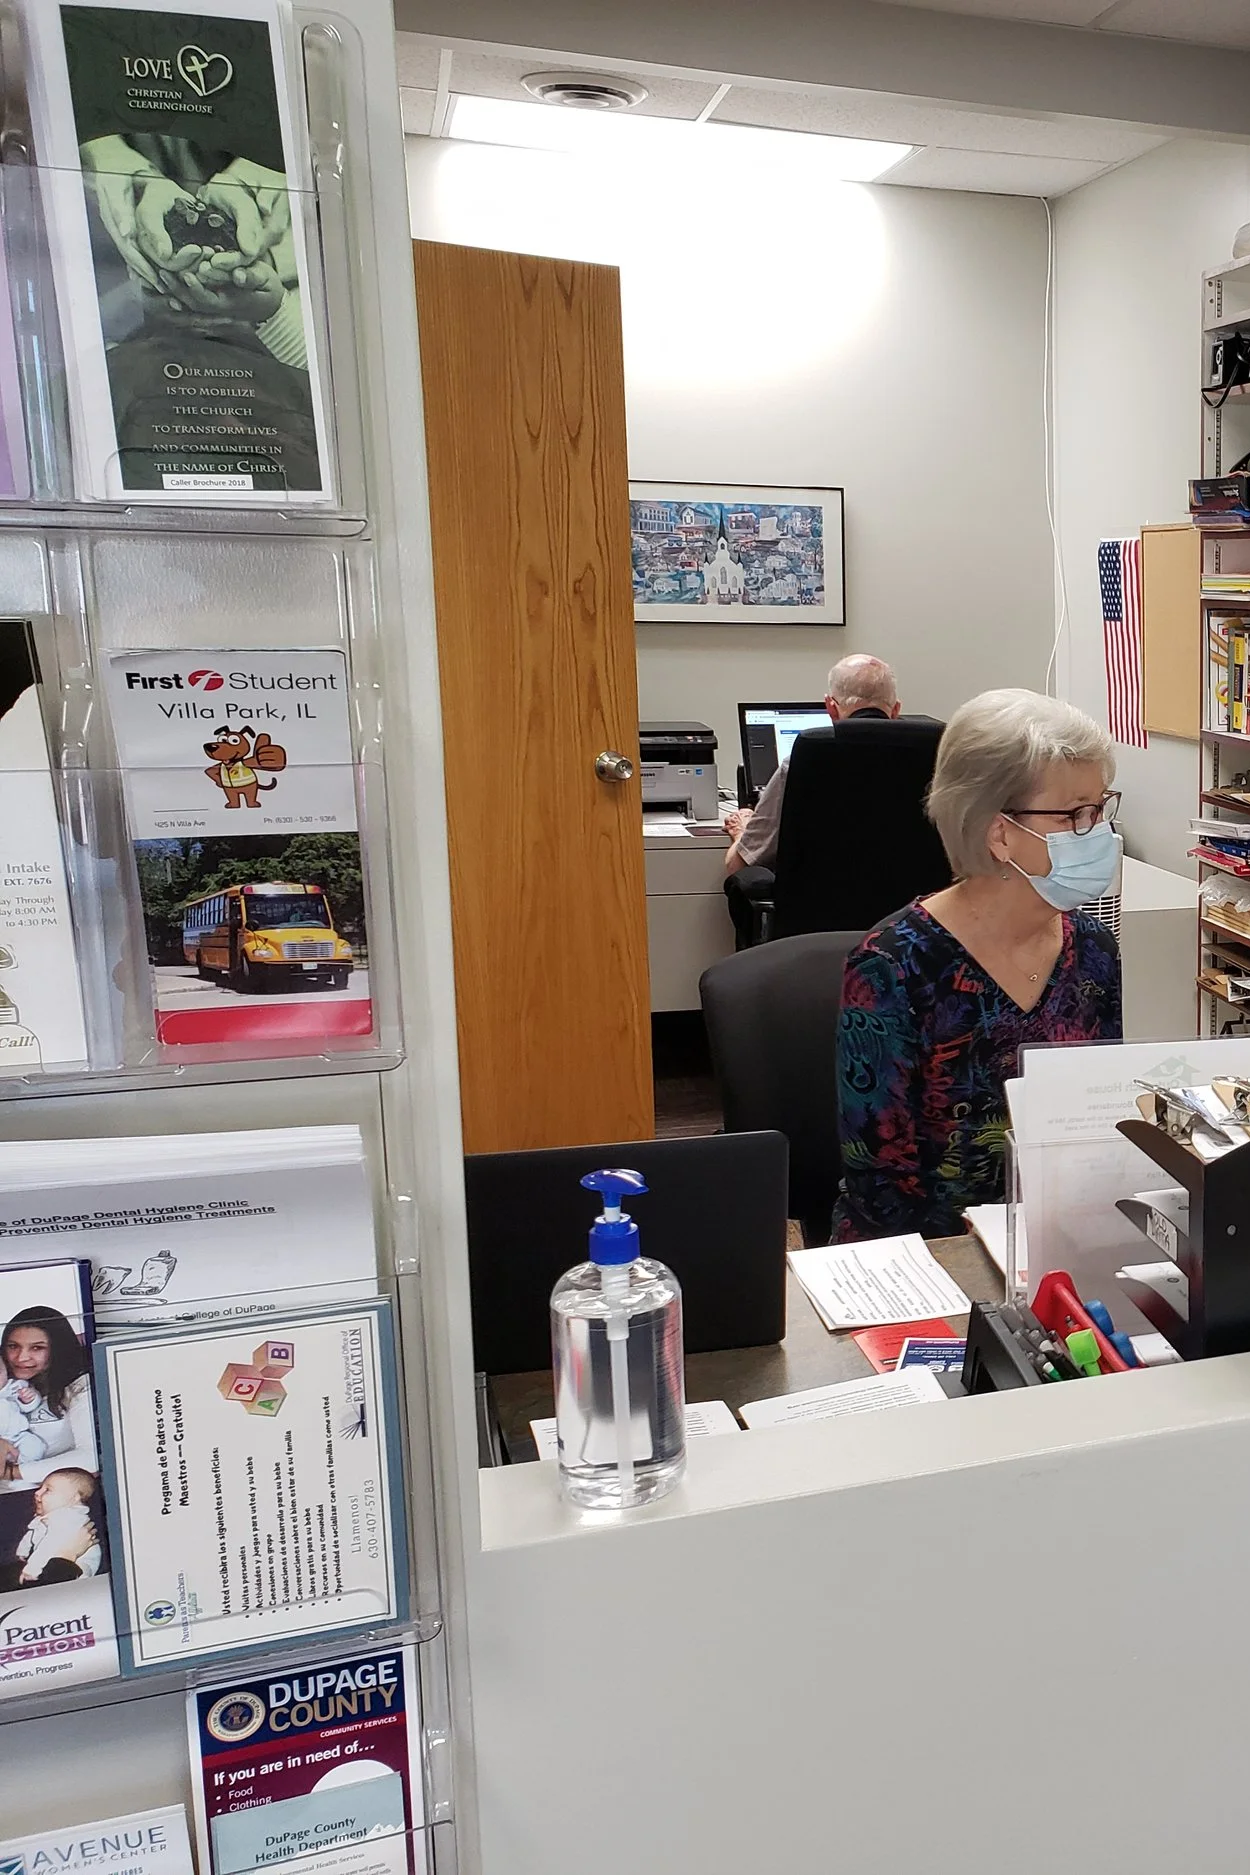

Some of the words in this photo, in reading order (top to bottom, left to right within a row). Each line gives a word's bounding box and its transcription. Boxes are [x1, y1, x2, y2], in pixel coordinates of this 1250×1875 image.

[122, 57, 173, 80] LOVE
[127, 88, 182, 99] CHRISTIAN
[128, 100, 213, 114] CLEARINGHOUSE
[203, 369, 253, 378] MISSION
[166, 386, 176, 395] IS
[179, 387, 196, 396] TO
[199, 387, 256, 398] MOBILIZE
[172, 406, 198, 415] THE
[200, 406, 253, 416] CHURCH
[151, 425, 171, 433] TO
[172, 425, 245, 435] TRANSFORM
[247, 426, 278, 435] LIVES
[152, 444, 179, 453] AND
[181, 444, 267, 454] COMMUNITIES
[269, 446, 282, 454] IN
[154, 463, 179, 472] THE
[182, 463, 216, 472] NAME
[217, 463, 234, 472] OF
[193, 479, 227, 487] Brochure
[228, 479, 246, 487] 2018
[125, 672, 184, 690] First
[229, 672, 338, 690] Student
[158, 703, 215, 719] Villa
[225, 702, 287, 721] Park,
[297, 702, 317, 719] IL
[6, 861, 51, 874] Intake
[4, 878, 25, 886] EXT.
[27, 877, 52, 885] 7676
[15, 896, 55, 906] Through
[15, 907, 36, 915] 8:00
[39, 906, 56, 914] AM
[18, 919, 39, 927] 4:30
[41, 918, 58, 926] PM
[11, 1218, 26, 1226] of
[31, 1213, 90, 1224] DuPage
[93, 1208, 141, 1219] Dental
[145, 1204, 204, 1215] Hygiene
[208, 1199, 249, 1209] Clinic
[81, 1218, 129, 1229] Dental
[134, 1214, 193, 1226] Hygiene
[196, 1206, 276, 1219] Treatments
[223, 1307, 232, 1316] of
[349, 1328, 364, 1403] EDUCATION
[233, 1381, 255, 1397] C
[154, 1389, 163, 1416] como
[155, 1418, 167, 1454] Padres
[158, 1456, 168, 1469] de
[245, 1456, 254, 1475] bebe
[273, 1462, 282, 1480] bebe
[287, 1466, 295, 1477] de
[176, 1459, 191, 1506] Maestros
[246, 1476, 255, 1485] su
[159, 1470, 172, 1515] Progama
[276, 1491, 284, 1508] para
[248, 1493, 257, 1514] usted
[214, 1496, 227, 1540] siguientes
[250, 1515, 259, 1532] para
[303, 1508, 312, 1526] bebe
[363, 1479, 379, 1559] 630-407-5783
[291, 1524, 300, 1544] sobre
[216, 1542, 227, 1554] los
[280, 1546, 287, 1556] de
[306, 1536, 315, 1553] para
[331, 1539, 339, 1549] de
[239, 1545, 250, 1585] personales
[266, 1555, 274, 1564] en
[320, 1553, 327, 1562] en
[217, 1555, 230, 1588] recibira
[220, 1589, 232, 1616] Usted
[5, 1614, 93, 1646] Parent
[36, 1662, 74, 1675] Progress
[268, 1659, 398, 1709] DUPAGE
[269, 1683, 397, 1732] COUNTY
[319, 1723, 362, 1738] COMMUNITY
[364, 1715, 397, 1729] SERVICES
[213, 1772, 226, 1787] If
[228, 1763, 256, 1785] you
[259, 1762, 284, 1776] are
[287, 1755, 301, 1768] in
[305, 1744, 341, 1762] need
[228, 1786, 253, 1800] Food
[229, 1795, 272, 1813] Clothing
[265, 1828, 311, 1847] DuPage
[314, 1816, 356, 1835] County
[32, 1825, 167, 1869] AVENUE
[110, 1844, 167, 1861] CENTER
[255, 1844, 295, 1863] Health
[298, 1827, 368, 1852] Department
